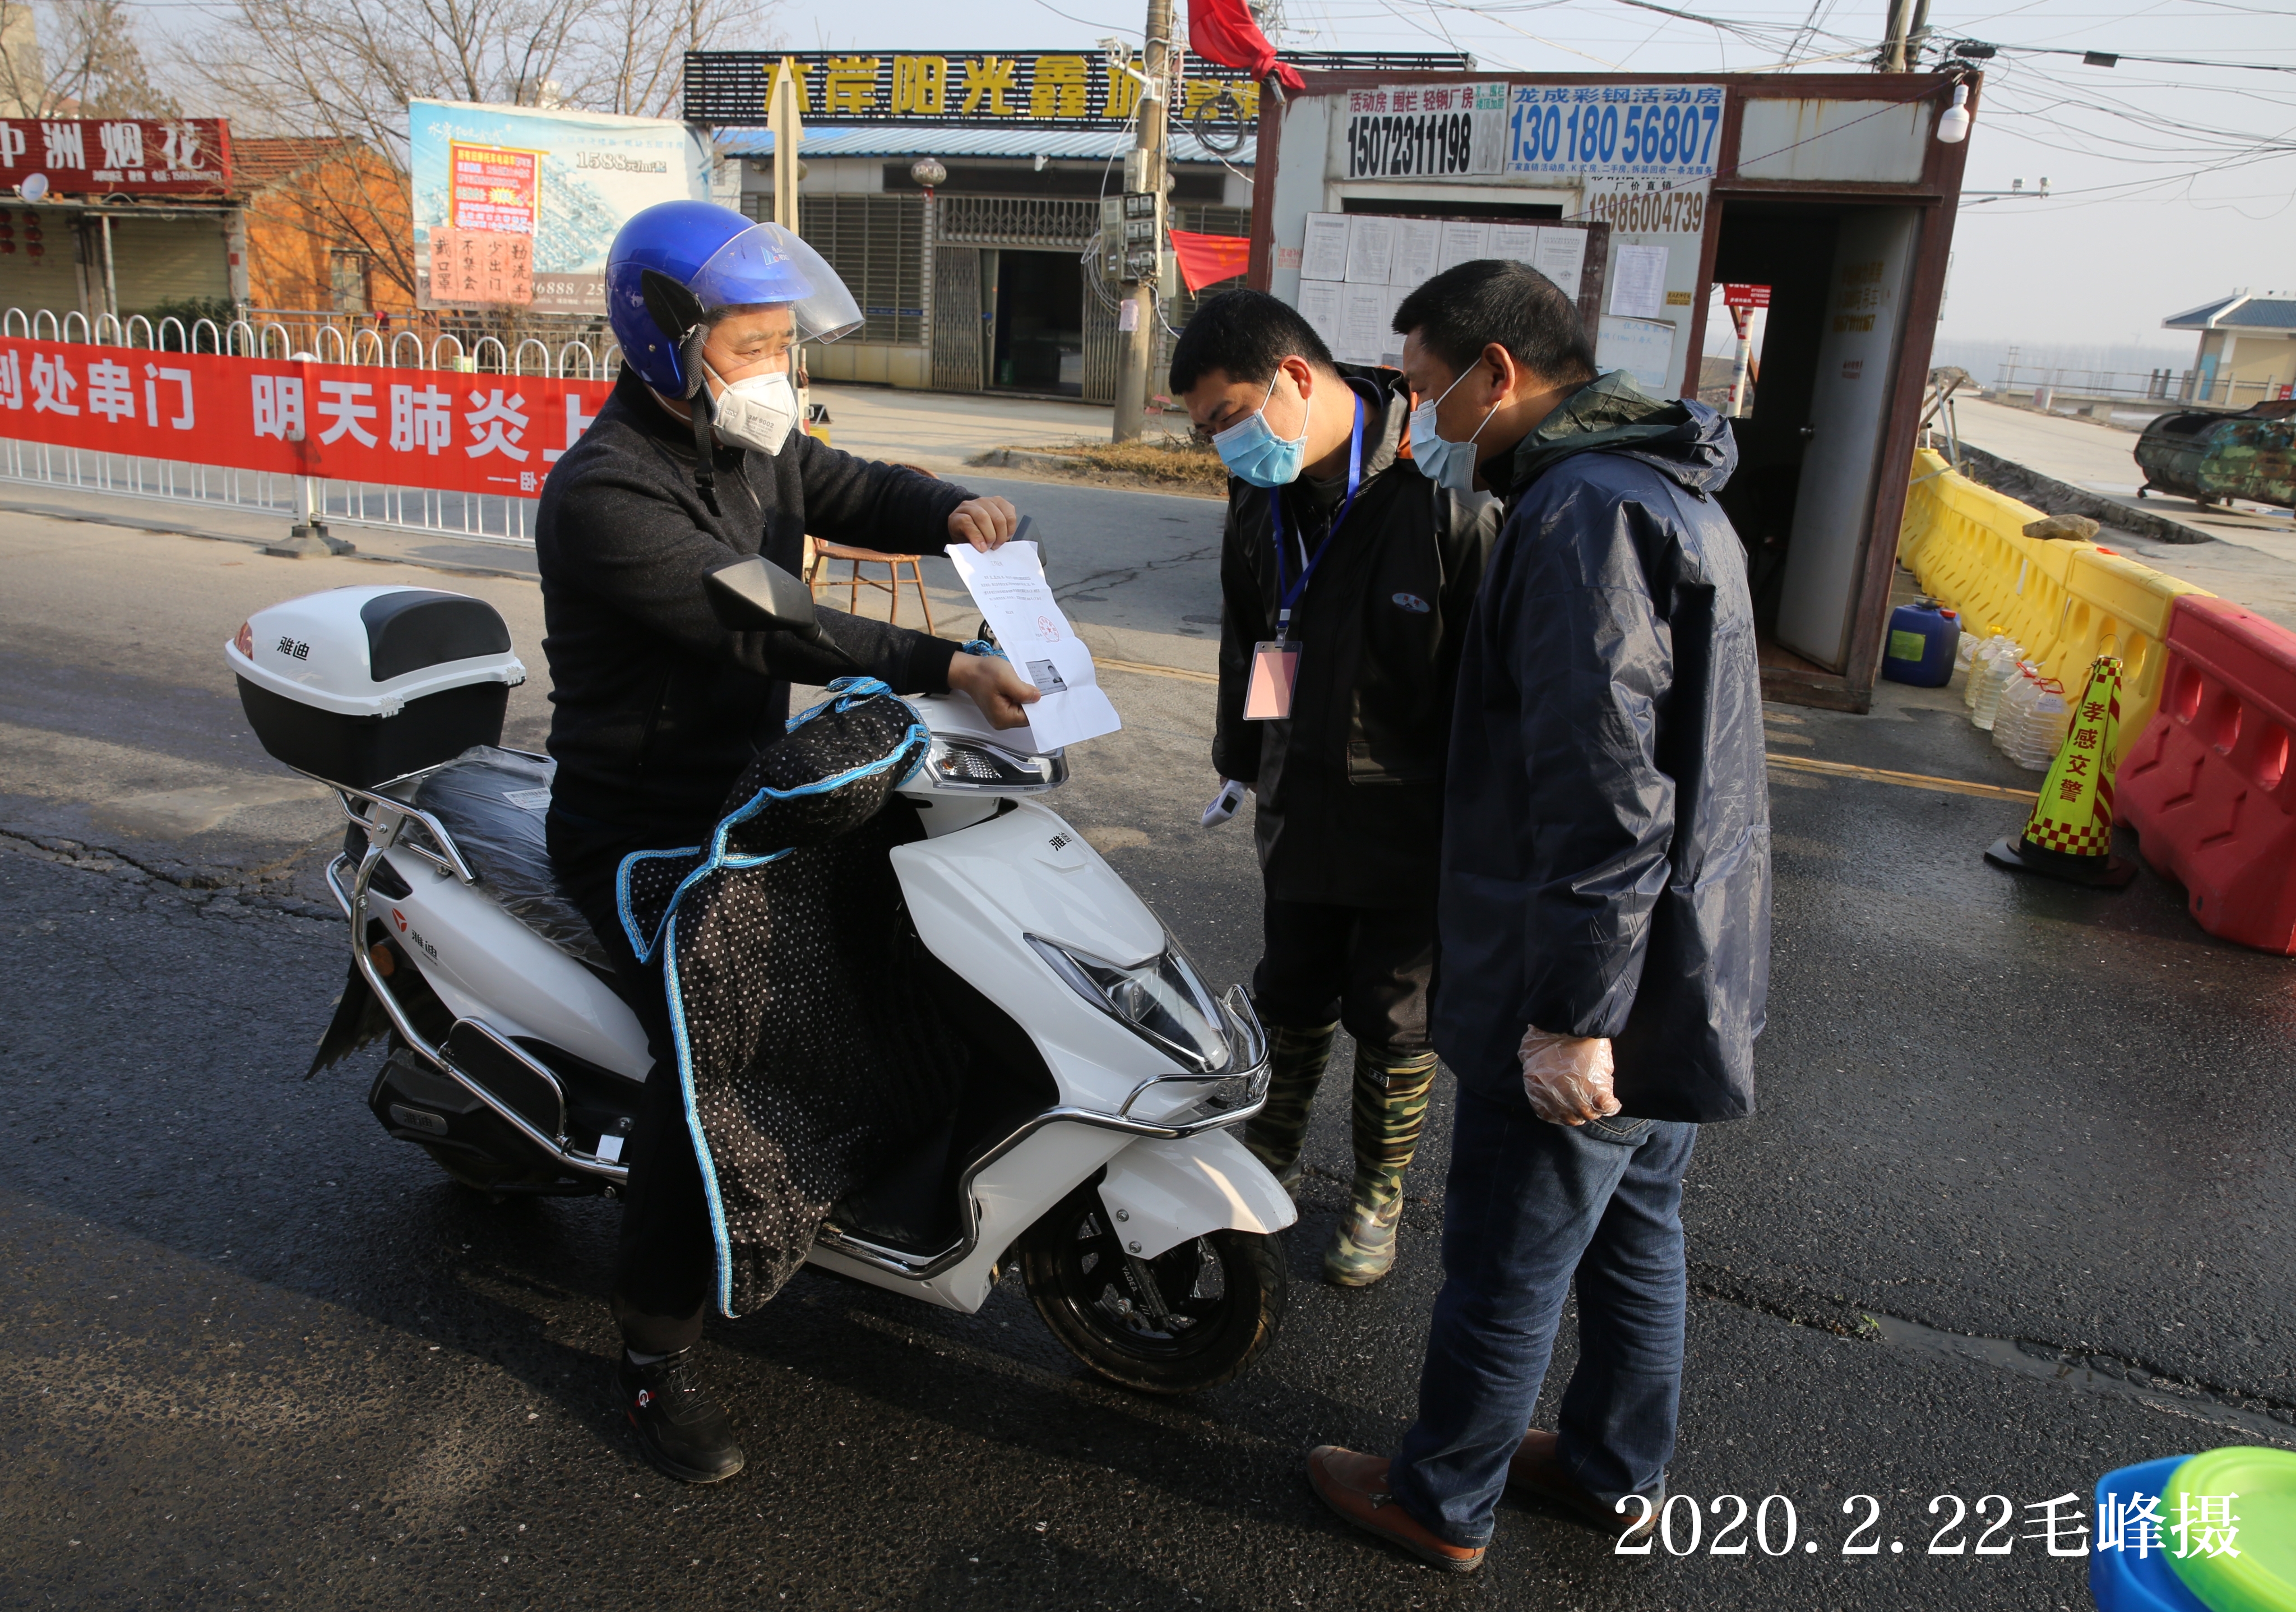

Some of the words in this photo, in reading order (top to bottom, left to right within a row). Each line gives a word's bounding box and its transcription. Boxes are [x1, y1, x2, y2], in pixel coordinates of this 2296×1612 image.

[1350, 91, 1387, 113] 活动房
[1392, 90, 1417, 112] 围栏
[1423, 86, 1474, 111] 轻钢厂房
[1513, 87, 1722, 104] 龙成彩钢活动房
[0, 121, 205, 170] 中洲烟花
[1348, 113, 1471, 178] 15072311198
[1615, 181, 1672, 191] 厂价直销
[1589, 191, 1703, 233] 13986004739
[0, 349, 195, 430] 到处串门
[276, 636, 310, 660] 雅迪
[2059, 701, 2105, 803] 孝感交警
[1049, 832, 1072, 851] 雅迪
[411, 929, 438, 960] 雅迪
[404, 1111, 434, 1129] 雅迪
